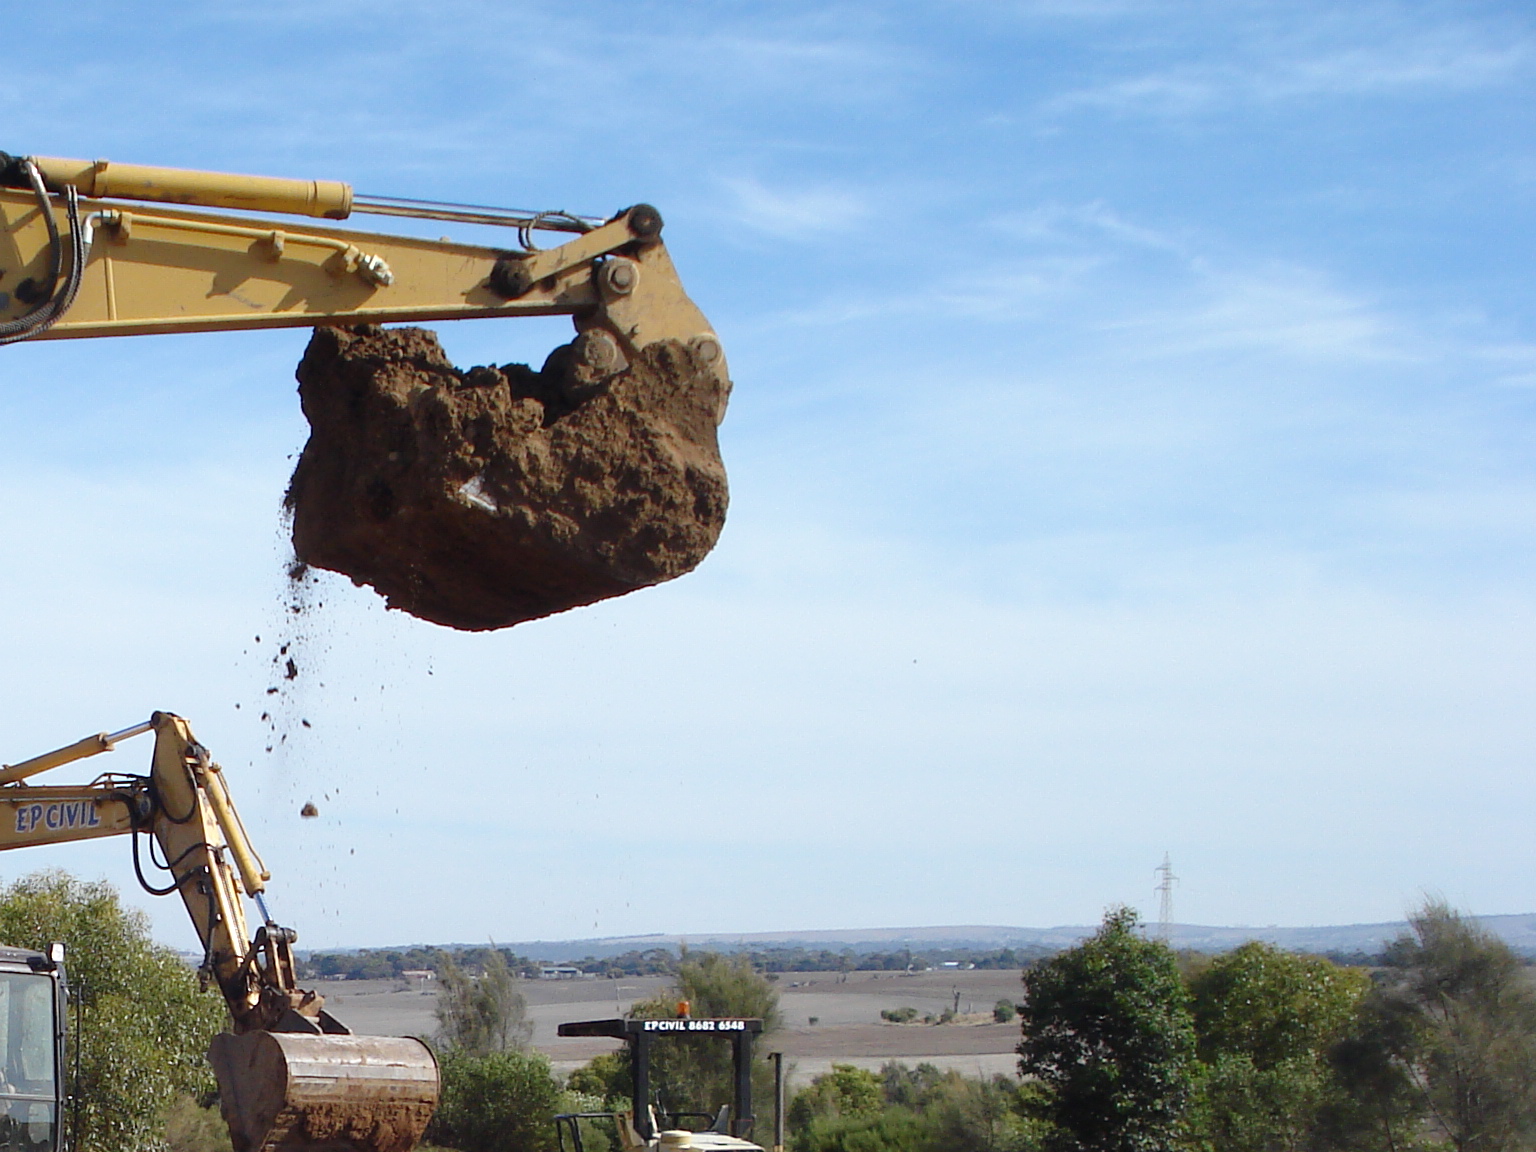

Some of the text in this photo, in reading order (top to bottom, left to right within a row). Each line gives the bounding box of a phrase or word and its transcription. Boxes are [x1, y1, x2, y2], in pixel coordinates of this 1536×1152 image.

[16, 802, 101, 832] EP CIVIL
[688, 1021, 715, 1031] 8682
[718, 1021, 745, 1031] 6548
